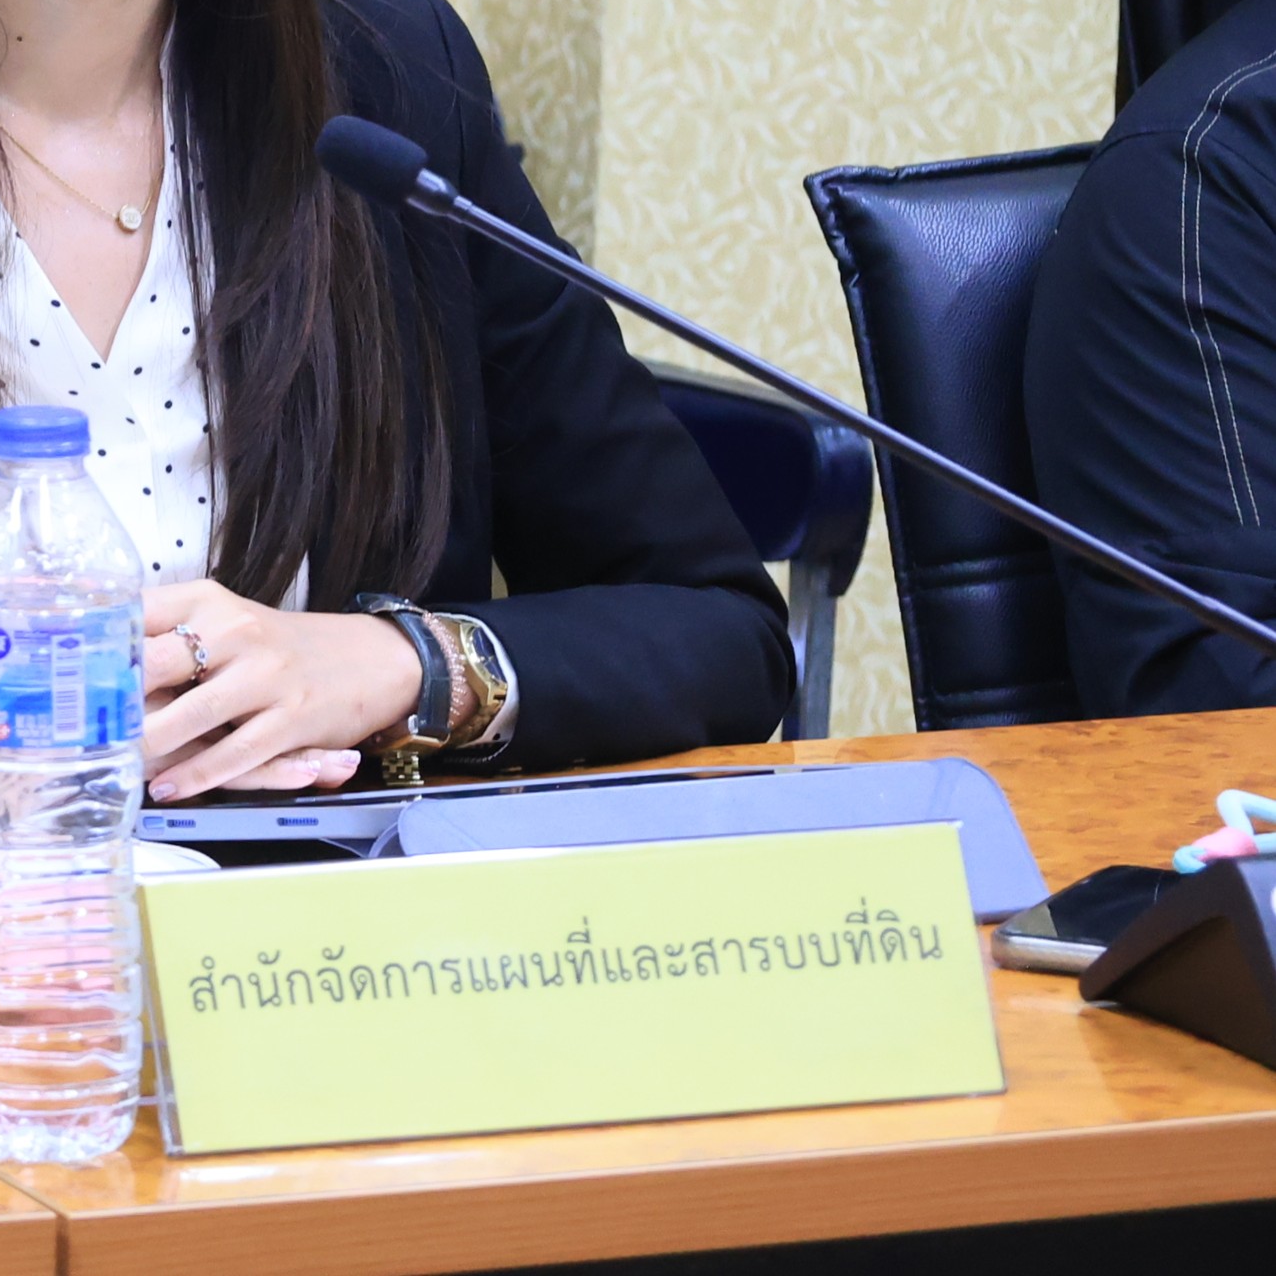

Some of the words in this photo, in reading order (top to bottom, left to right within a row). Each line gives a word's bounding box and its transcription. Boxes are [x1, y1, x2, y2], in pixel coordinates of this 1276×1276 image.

[188, 896, 943, 1013] สำนักจัดการแผนที่และสารบบที่ดิน
